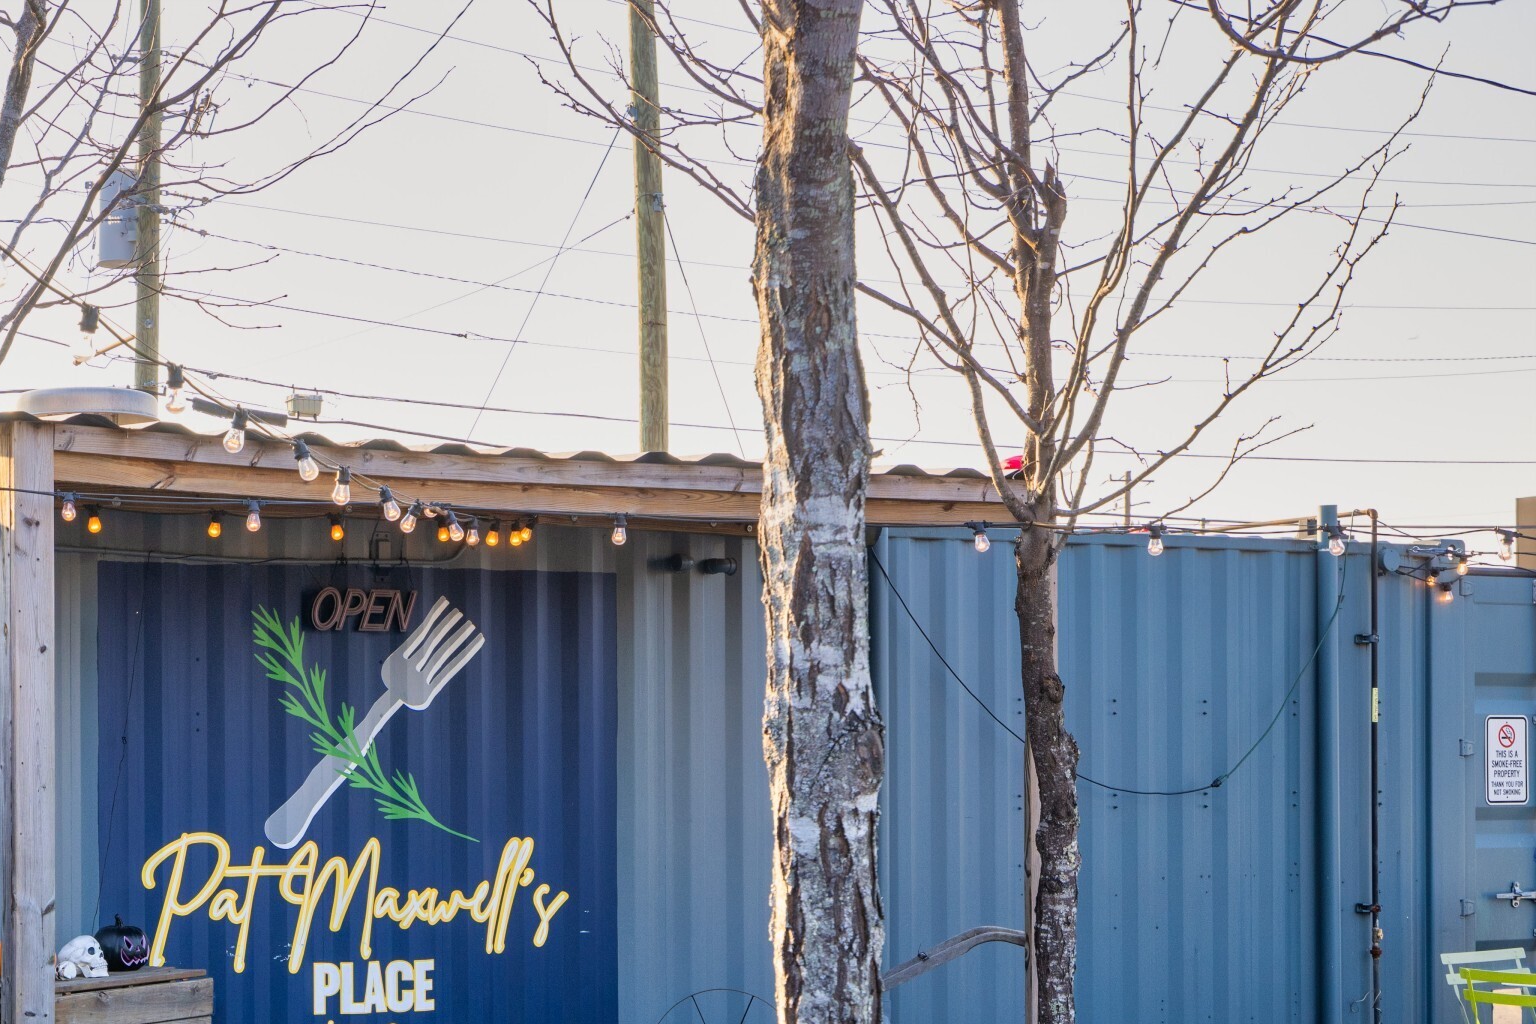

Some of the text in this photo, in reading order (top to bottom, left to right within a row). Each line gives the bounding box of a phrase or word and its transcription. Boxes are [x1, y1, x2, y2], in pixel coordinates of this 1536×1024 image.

[311, 586, 418, 632] OPEN
[1491, 760, 1522, 768] SMOKE-FREE
[1496, 750, 1518, 758] THIS IS A
[141, 832, 569, 974] Pat Maxwell's
[313, 958, 435, 1015] PLACE
